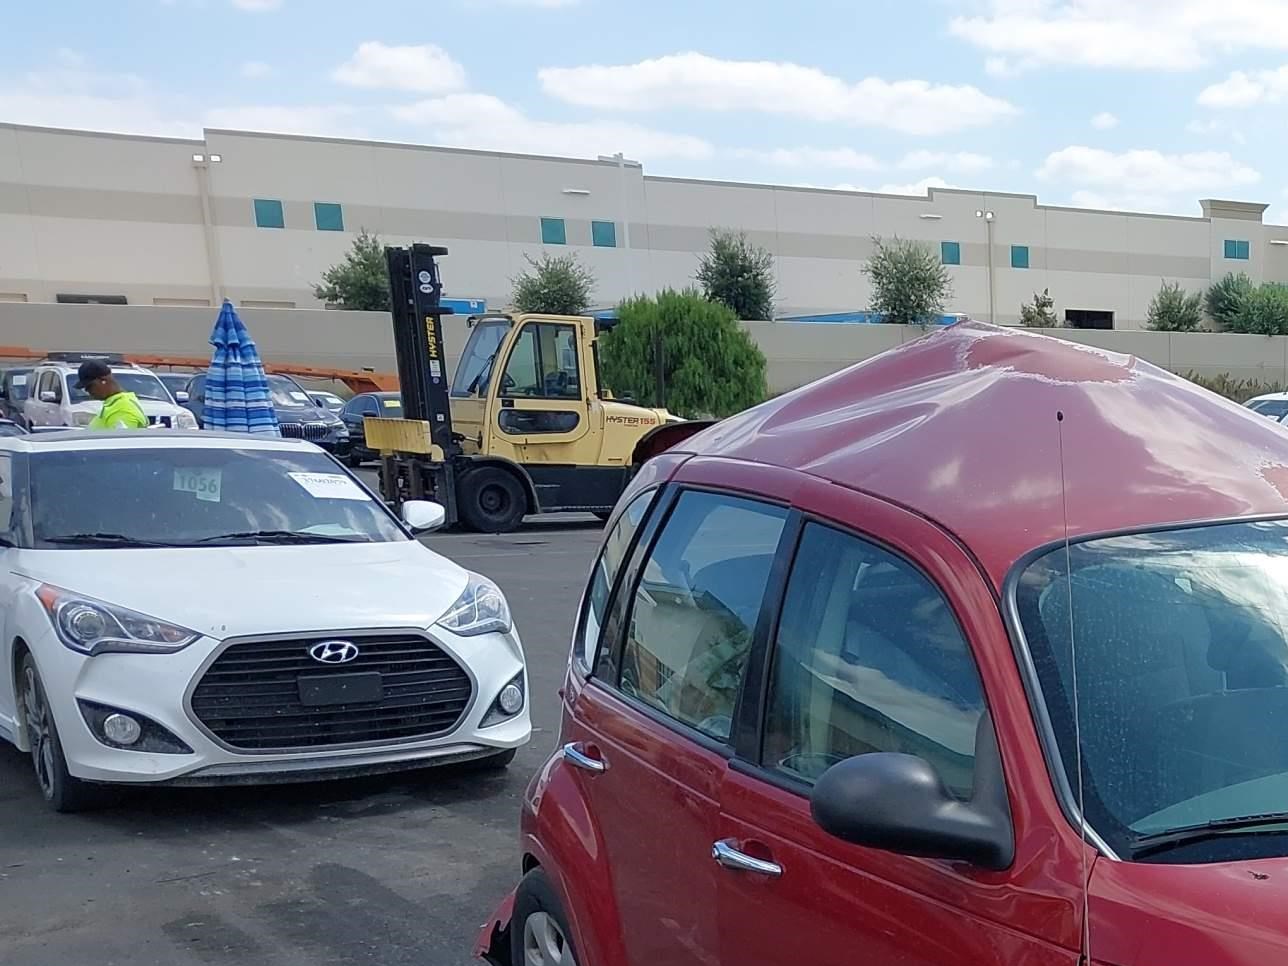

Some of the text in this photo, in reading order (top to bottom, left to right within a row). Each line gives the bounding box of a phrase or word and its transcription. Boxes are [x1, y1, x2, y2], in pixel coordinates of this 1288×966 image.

[426, 316, 438, 358] HYSTER
[606, 416, 656, 425] HYSTER 155
[179, 475, 217, 494] 1056
